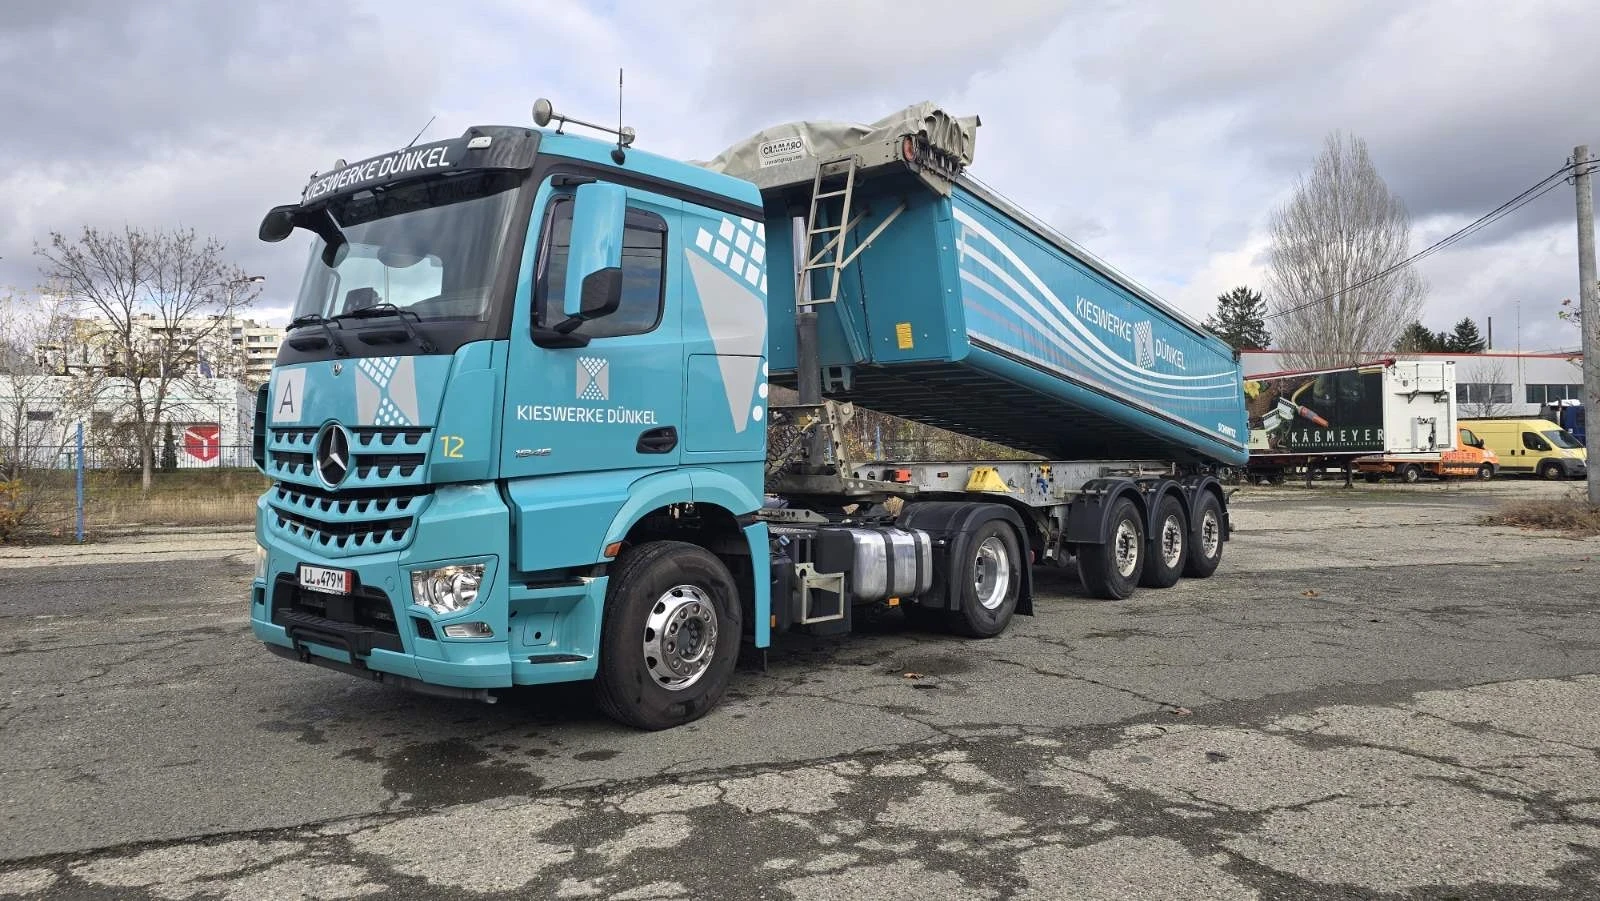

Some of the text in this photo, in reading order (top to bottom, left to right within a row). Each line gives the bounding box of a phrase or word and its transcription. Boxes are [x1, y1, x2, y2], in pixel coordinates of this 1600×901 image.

[763, 141, 802, 155] CRAMARO
[304, 146, 450, 201] KIESWERKE DÜNKEL
[1076, 295, 1186, 371] KIESWERKE DÜNKEL
[279, 378, 294, 415] A
[516, 404, 658, 425] KIESWERKE DÜNKEL
[440, 436, 464, 458] 12
